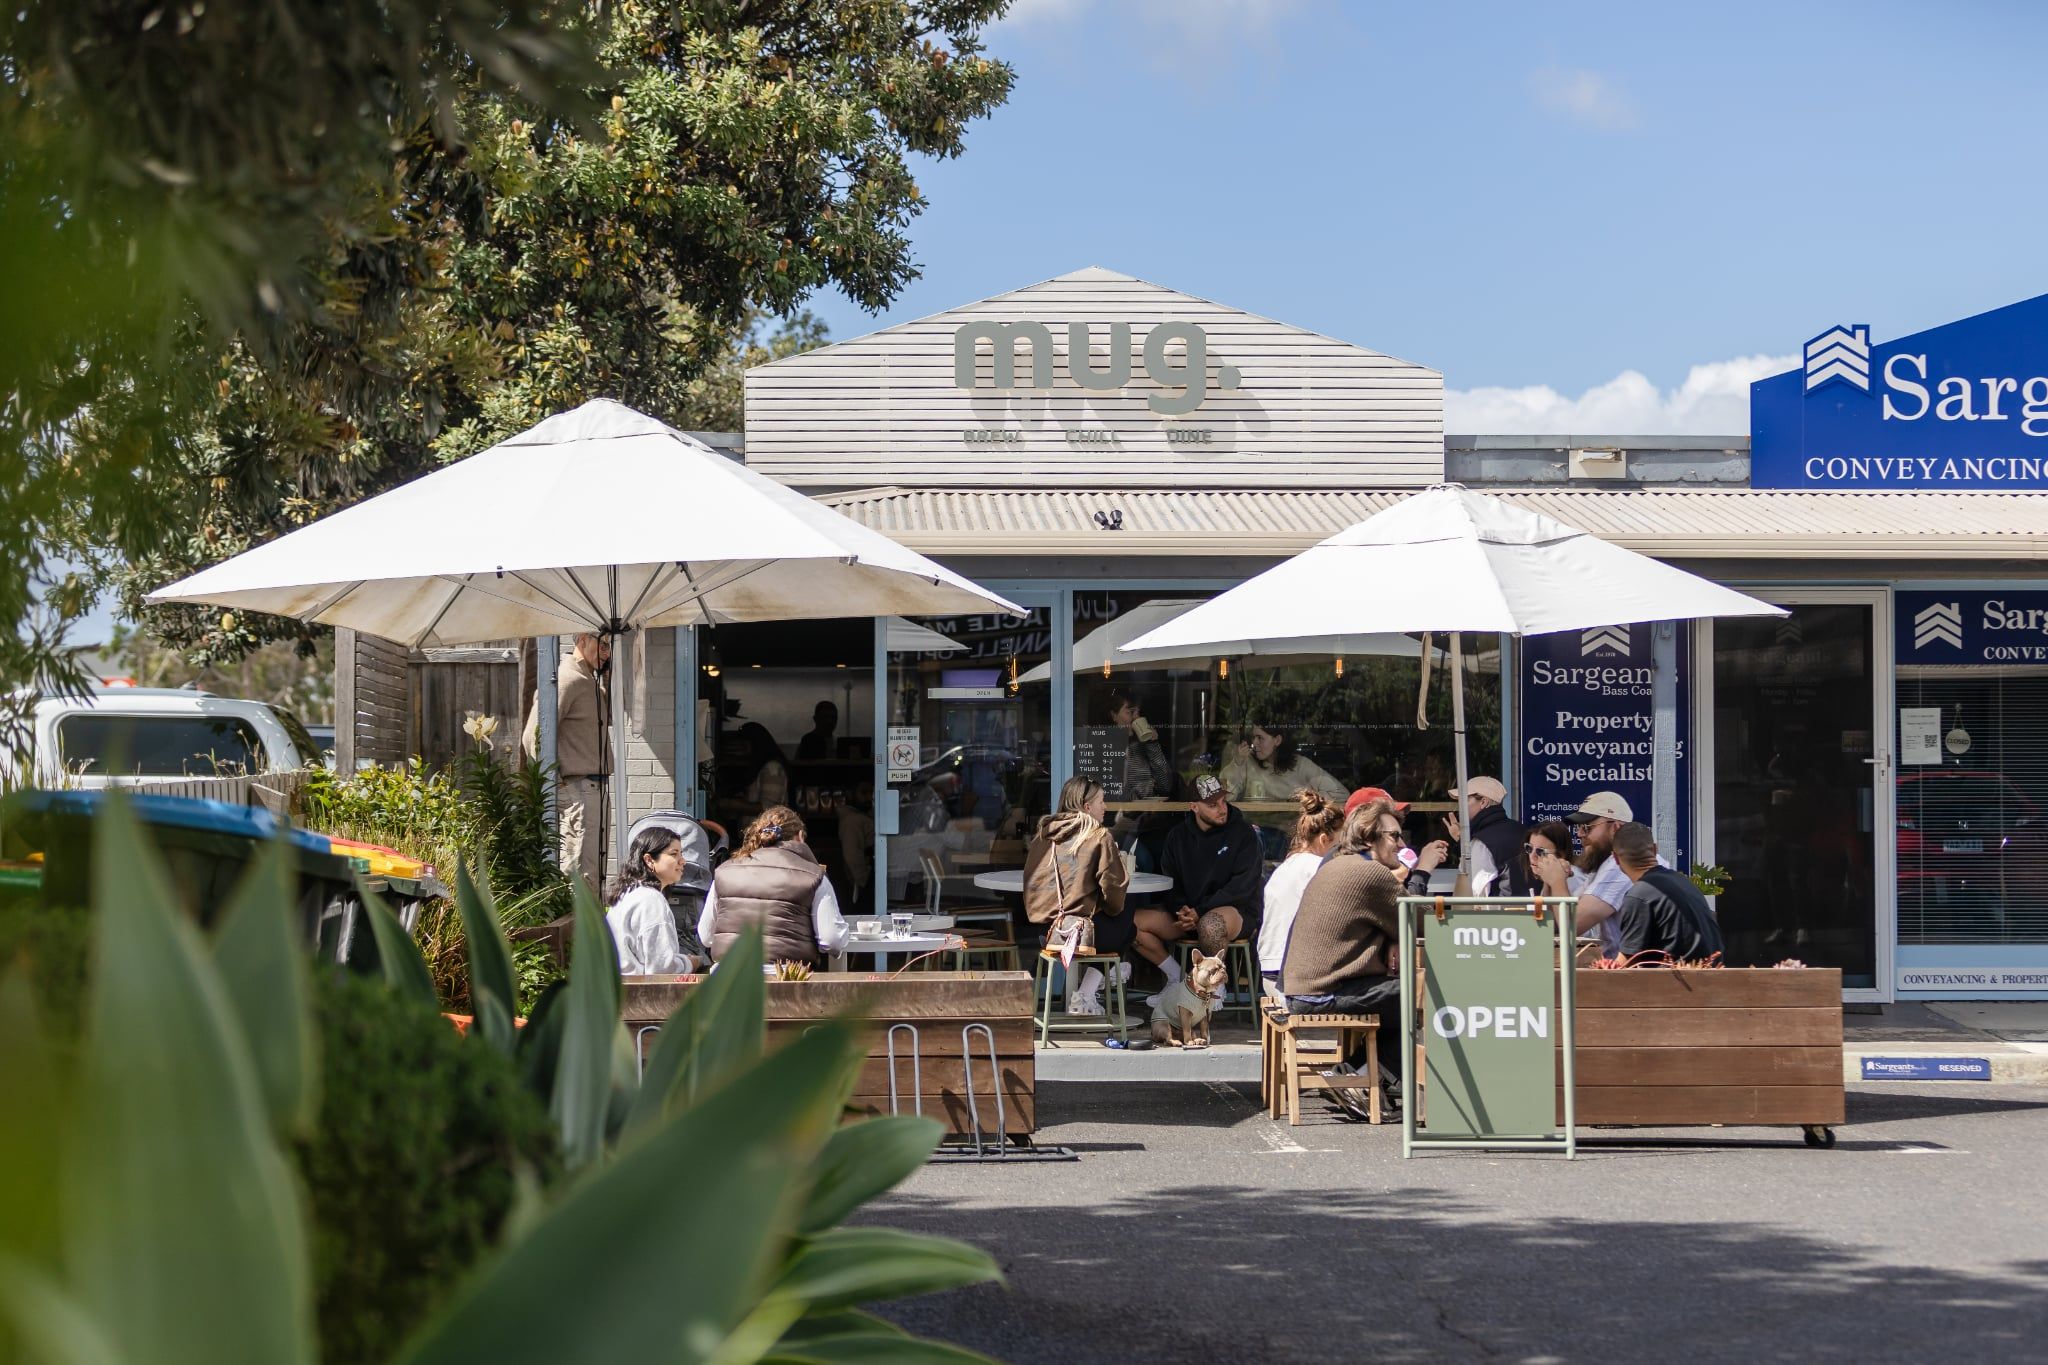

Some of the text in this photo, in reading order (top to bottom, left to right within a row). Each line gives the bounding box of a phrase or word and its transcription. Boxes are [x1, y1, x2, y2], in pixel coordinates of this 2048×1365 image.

[954, 320, 1242, 416] mug.
[963, 428, 1213, 444] BREW CHILL DINE
[1805, 457, 2048, 480] CONVEYANCIN
[1983, 646, 2048, 660] CONVE
[1533, 660, 1678, 691] Sargean
[1602, 685, 1652, 696] Bass Coa
[1555, 711, 1653, 733] Property
[1527, 736, 1684, 759] Conveyancig
[1537, 802, 1580, 812] Purchase
[1537, 813, 1562, 823] Sales
[1454, 927, 1526, 952] mug.
[1904, 974, 1986, 984] CONVEYANCING
[1990, 974, 1998, 984] &
[1433, 1005, 1548, 1039] OPEN
[1938, 1064, 1982, 1072] RESERVED
